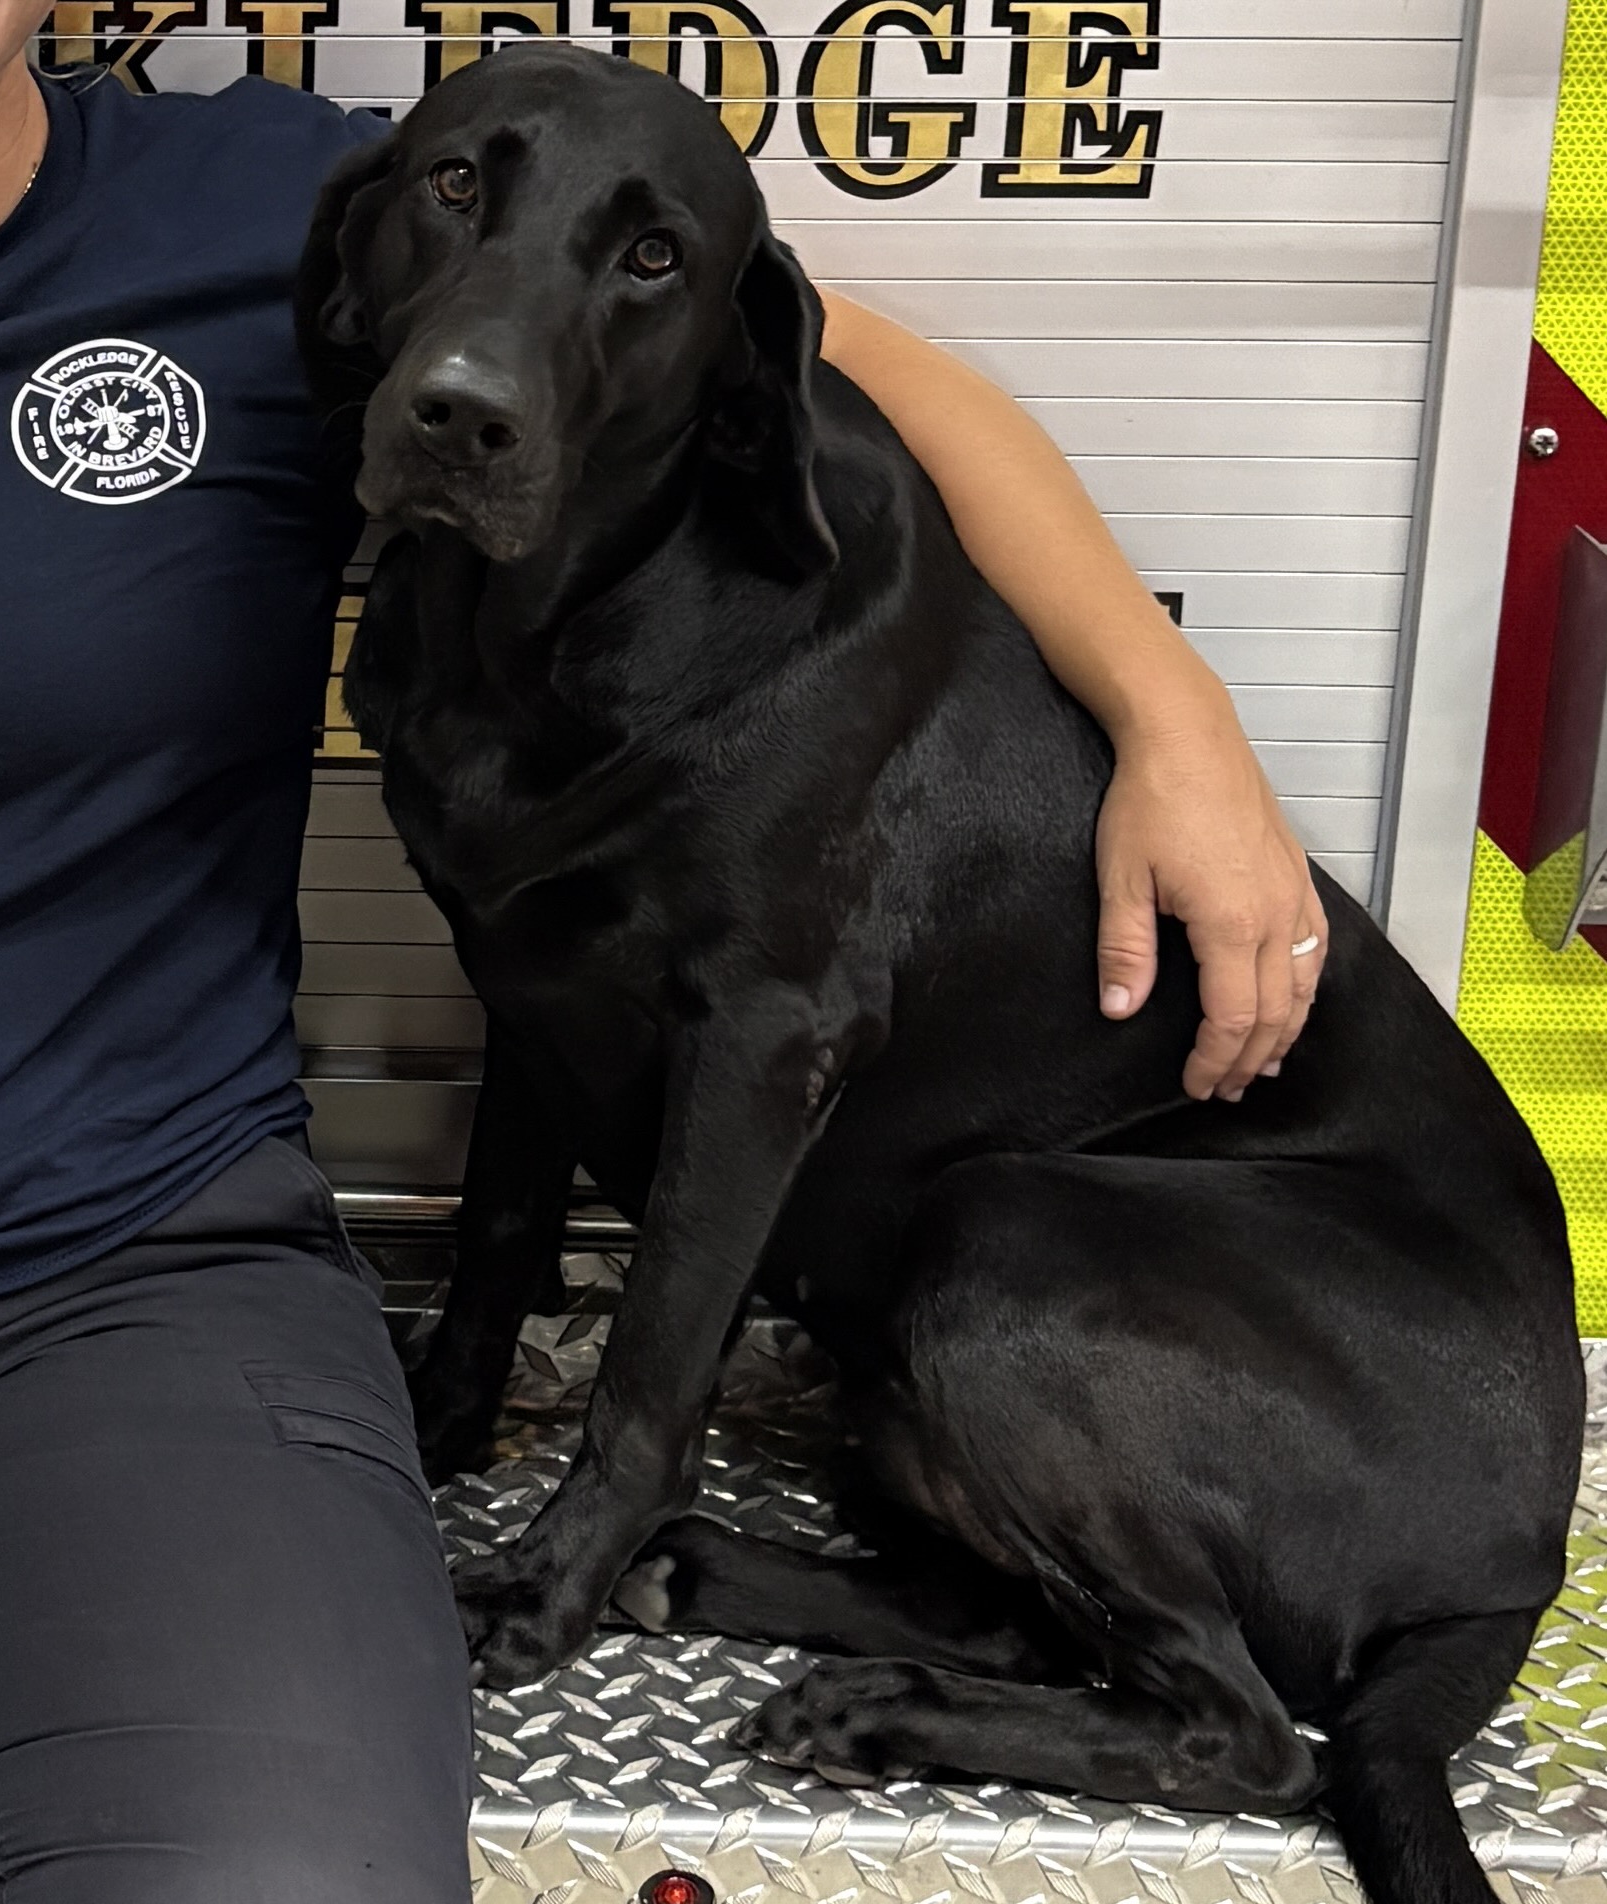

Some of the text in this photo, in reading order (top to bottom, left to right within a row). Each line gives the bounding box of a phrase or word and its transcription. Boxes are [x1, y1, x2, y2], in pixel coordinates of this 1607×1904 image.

[49, 352, 139, 384] ROCKLEDGE
[58, 377, 159, 419] OLDEST CITY
[164, 371, 192, 450] RESCUE
[27, 407, 49, 461] FIRE
[67, 426, 162, 467] IN BREVARD
[96, 467, 161, 489] FLORIDA
